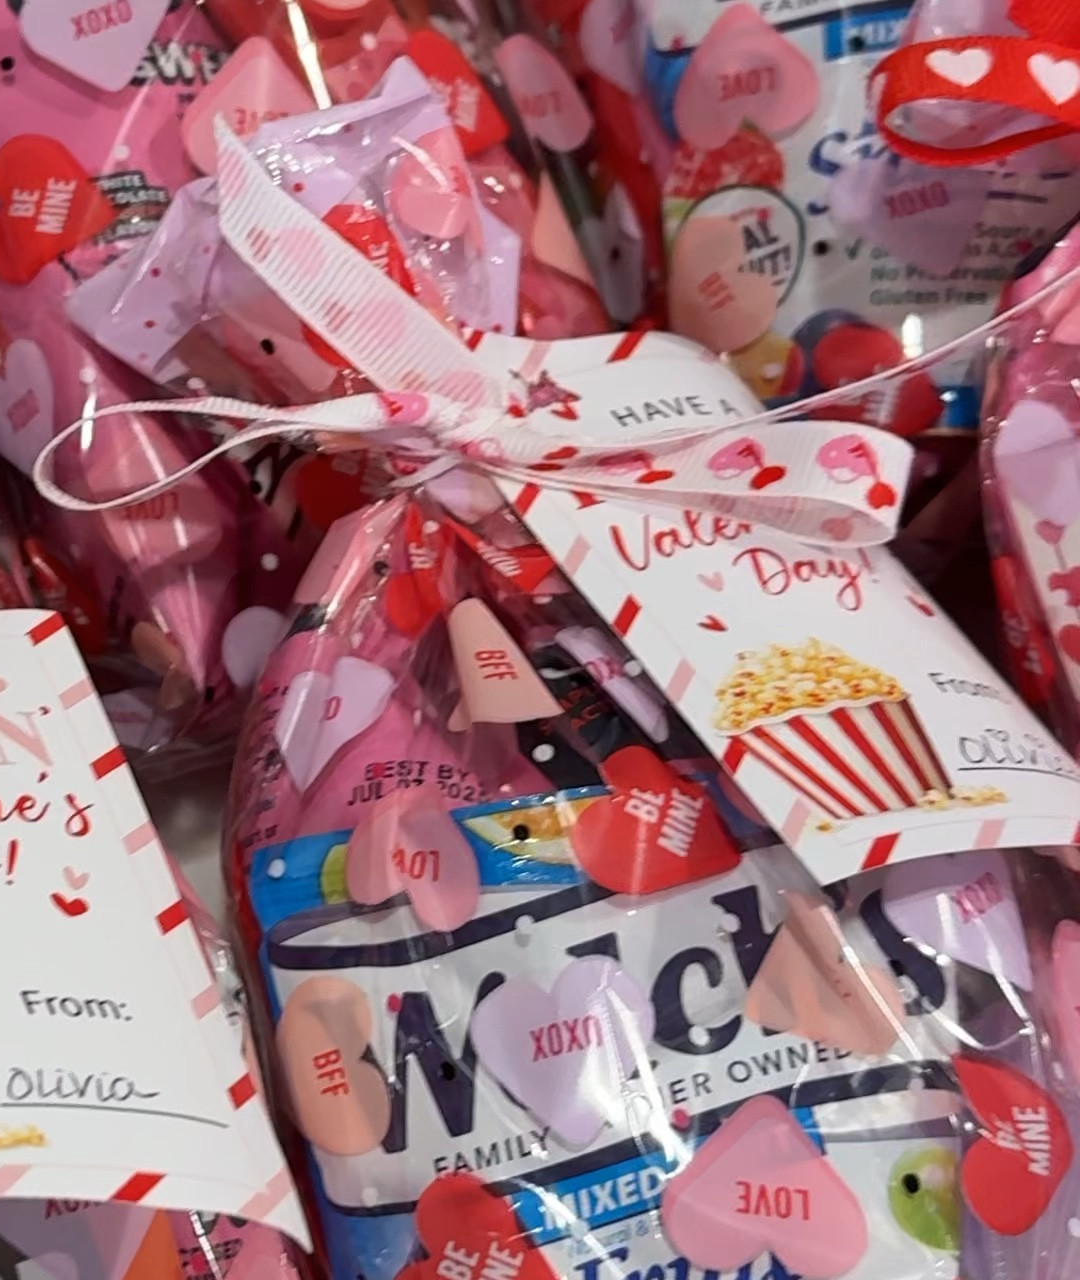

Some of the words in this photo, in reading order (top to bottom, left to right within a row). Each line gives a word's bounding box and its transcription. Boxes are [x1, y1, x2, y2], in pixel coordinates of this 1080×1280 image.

[718, 67, 779, 102] LOVE
[8, 188, 39, 218] BE
[35, 177, 77, 235] MINE
[610, 395, 712, 427] HAVE
[718, 398, 742, 418] A
[732, 547, 880, 611] Day!
[475, 649, 518, 681] BFF
[624, 788, 666, 824] BE
[656, 788, 704, 858] MINE
[21, 989, 133, 1022] From:
[312, 1048, 349, 1097] BFF
[432, 1126, 551, 1176] FAMILY
[1015, 1106, 1050, 1177] MINE
[735, 1180, 810, 1221] LOVE
